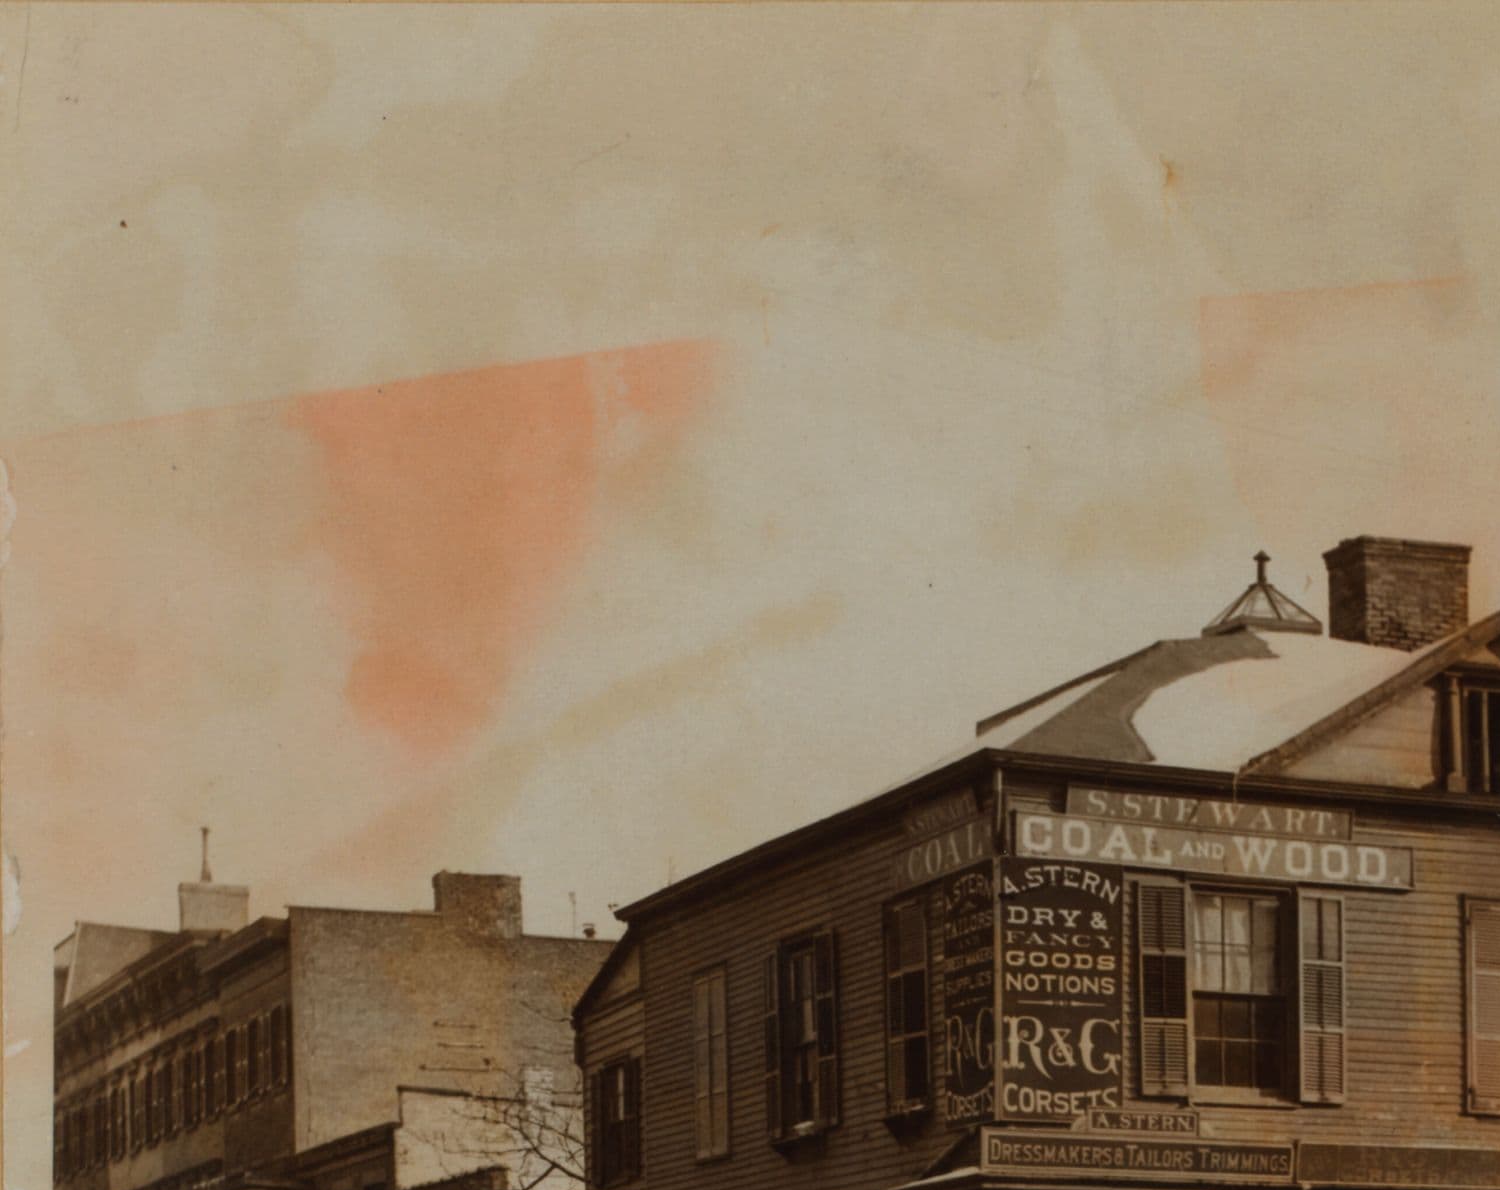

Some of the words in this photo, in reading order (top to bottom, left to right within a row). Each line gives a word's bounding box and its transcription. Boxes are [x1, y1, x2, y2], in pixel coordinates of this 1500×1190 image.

[1021, 815, 1172, 866] COAL
[1180, 839, 1225, 861] AND
[1003, 865, 1120, 904] A.STERN
[1006, 905, 1082, 928] DRY
[1090, 911, 1108, 930] &
[1006, 930, 1115, 949] FANCY
[1006, 950, 1116, 971] GOODS
[1005, 972, 1116, 995] NOTIONS
[1002, 1015, 1122, 1080] R&G
[1003, 1082, 1119, 1115] CORSETS
